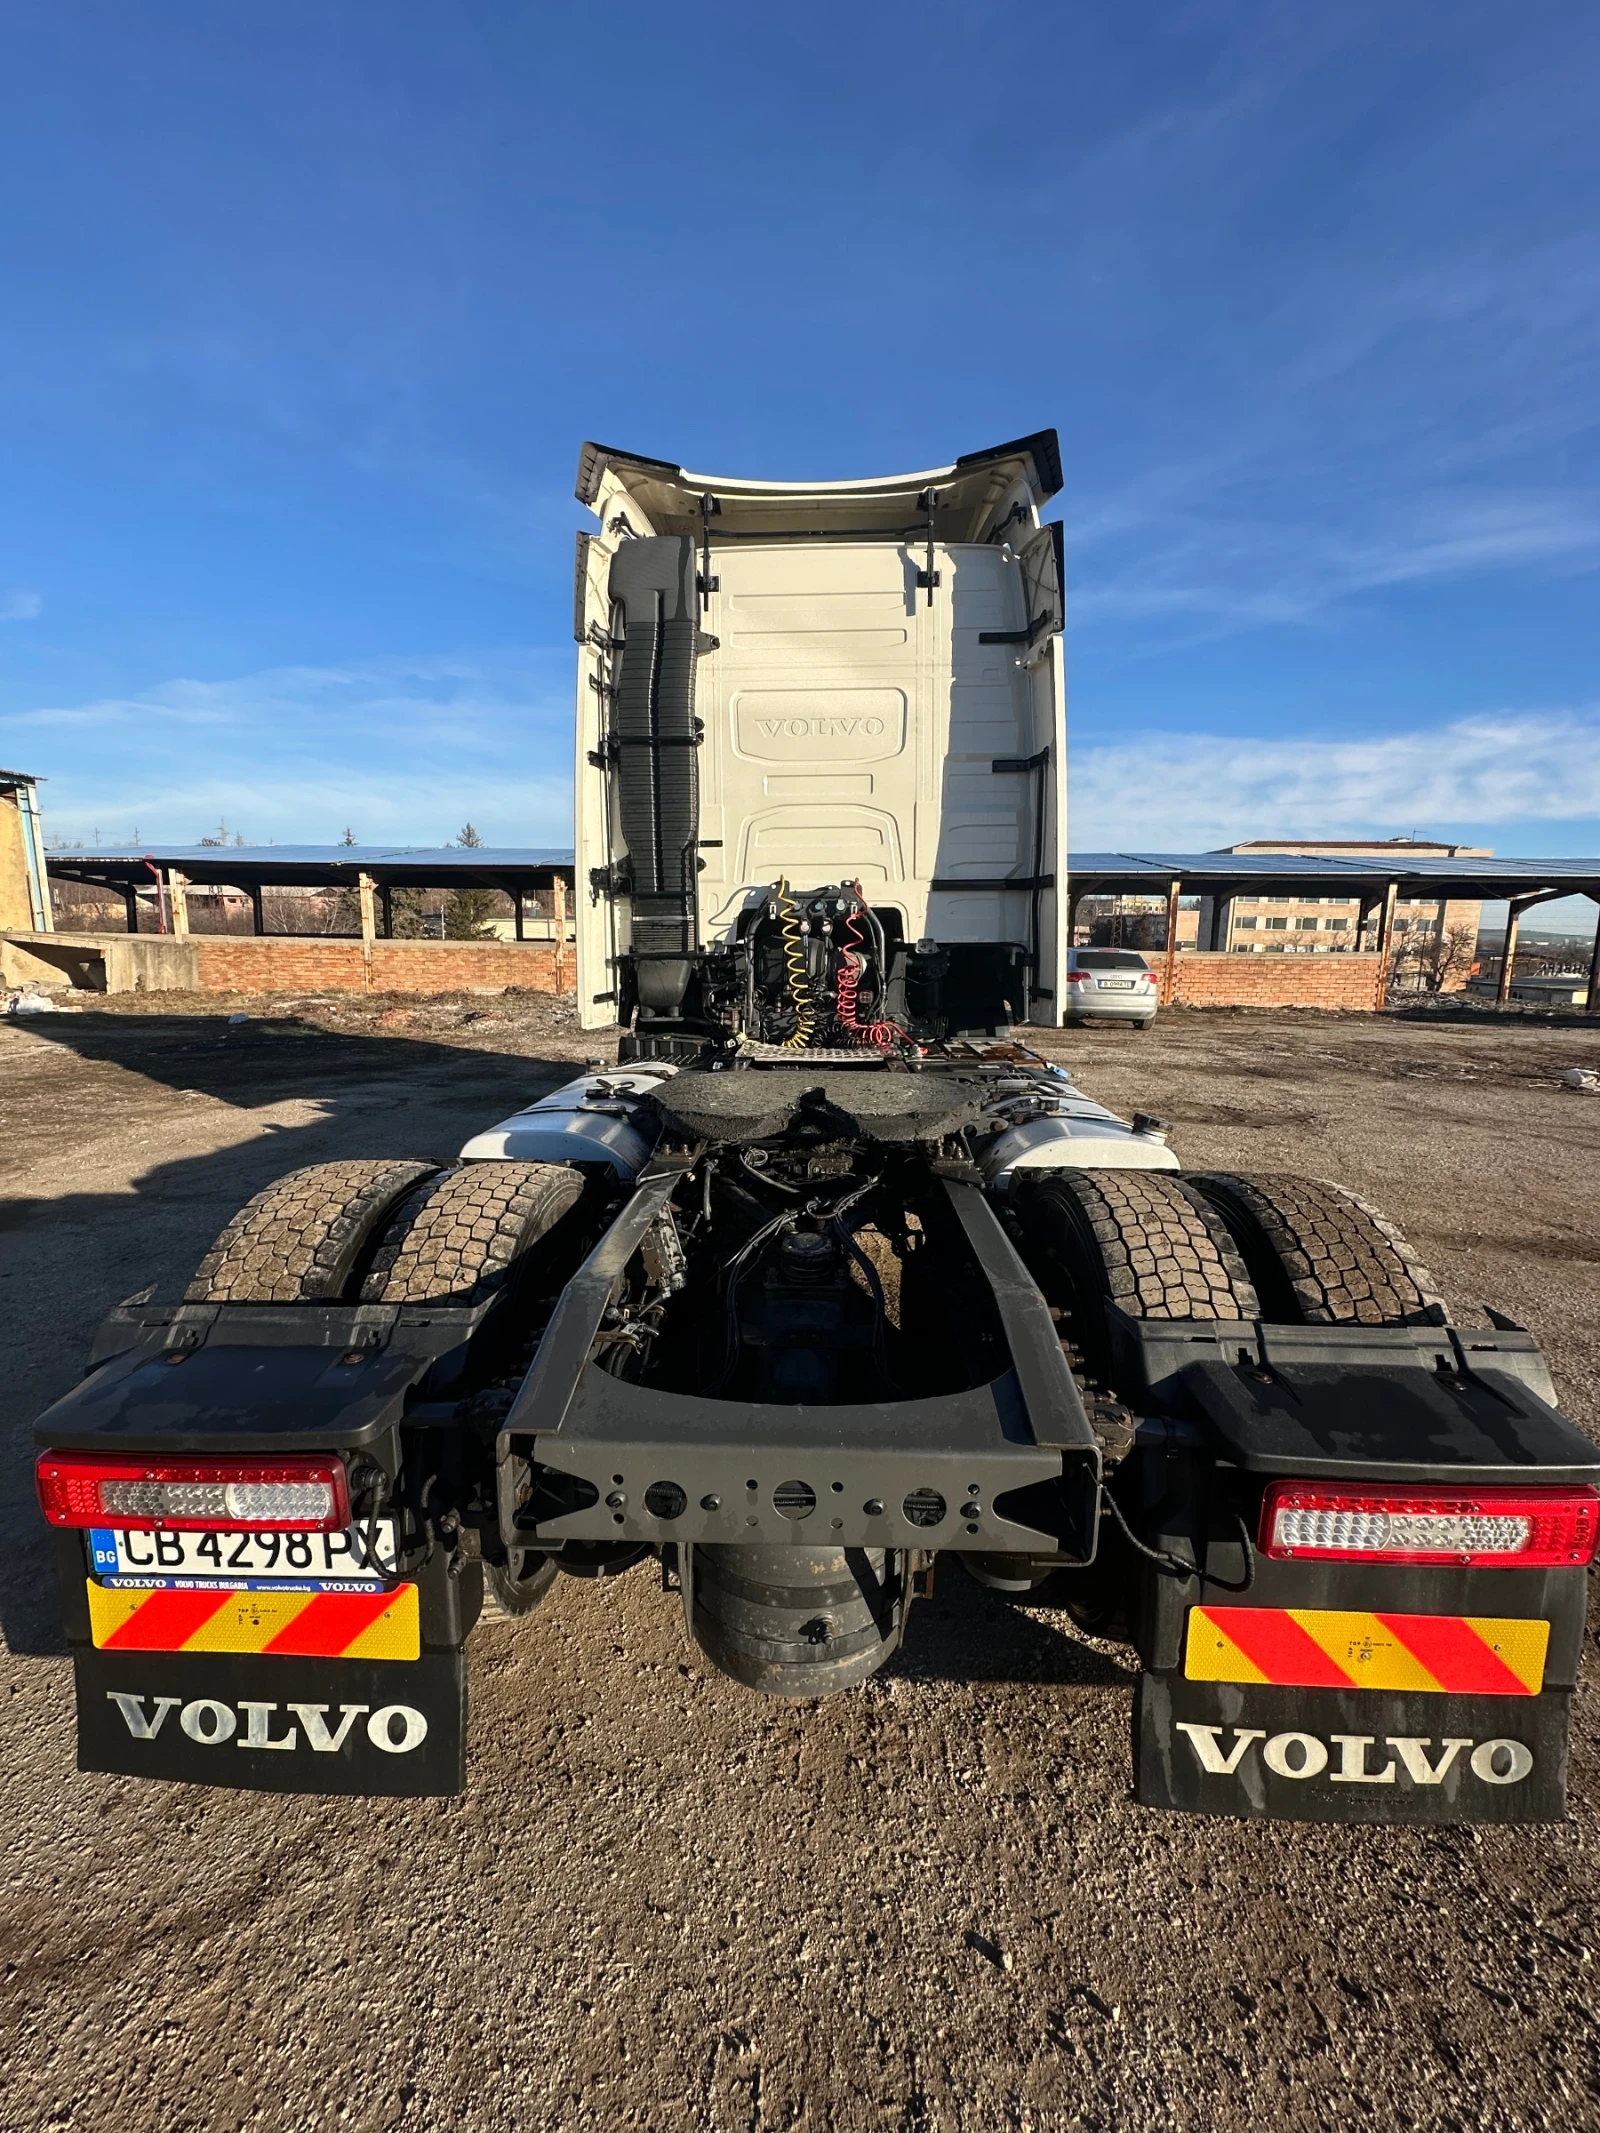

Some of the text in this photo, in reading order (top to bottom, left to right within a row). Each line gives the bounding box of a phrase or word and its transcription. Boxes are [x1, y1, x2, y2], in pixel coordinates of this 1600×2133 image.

[753, 717, 885, 738] VOLVO
[95, 1550, 117, 1564] BG
[123, 1531, 185, 1566] CB
[197, 1532, 313, 1569] 4298
[110, 1578, 167, 1588] VOLVO
[174, 1580, 249, 1590] VOLVO TRUCKS BULGARIA
[319, 1582, 376, 1592] VOLVO
[107, 1691, 428, 1754] VOLVO
[1176, 1721, 1534, 1785] VOLVO
